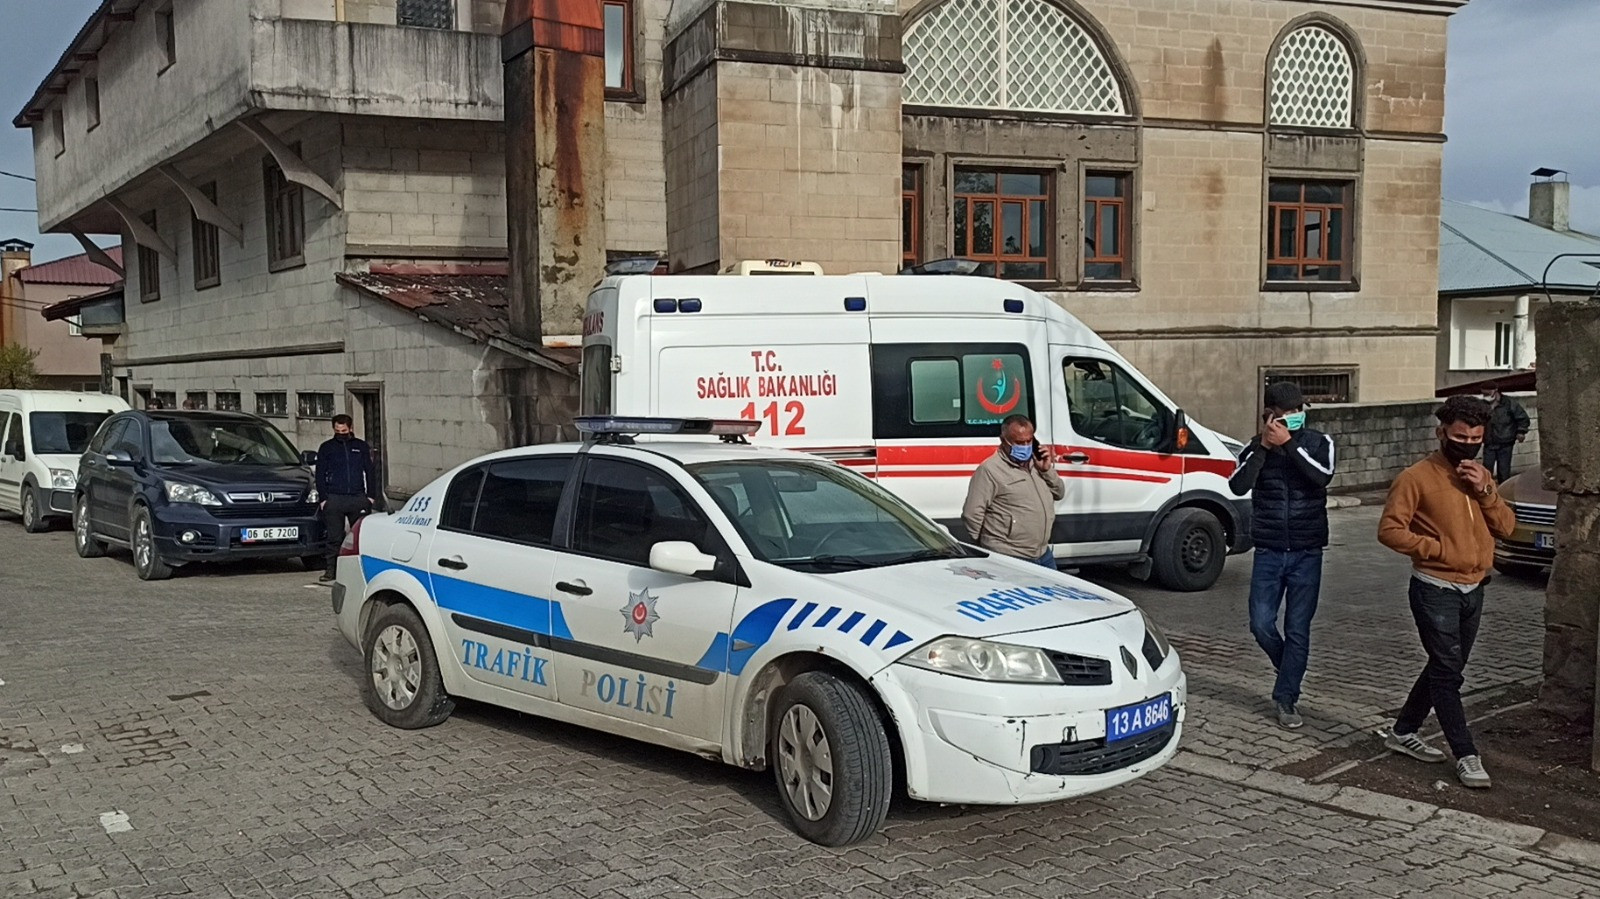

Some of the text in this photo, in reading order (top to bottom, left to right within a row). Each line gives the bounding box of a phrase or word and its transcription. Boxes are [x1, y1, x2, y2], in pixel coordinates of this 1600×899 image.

[751, 350, 782, 372] T.C.
[697, 369, 837, 399] SAĞLIK BAKANLIĞI
[740, 400, 806, 437] 112
[408, 496, 432, 512] 155
[247, 528, 297, 539] 06 GE 7200
[462, 638, 677, 719] TRAFİK POLİSİ
[1112, 699, 1169, 735] 13 A 8646
